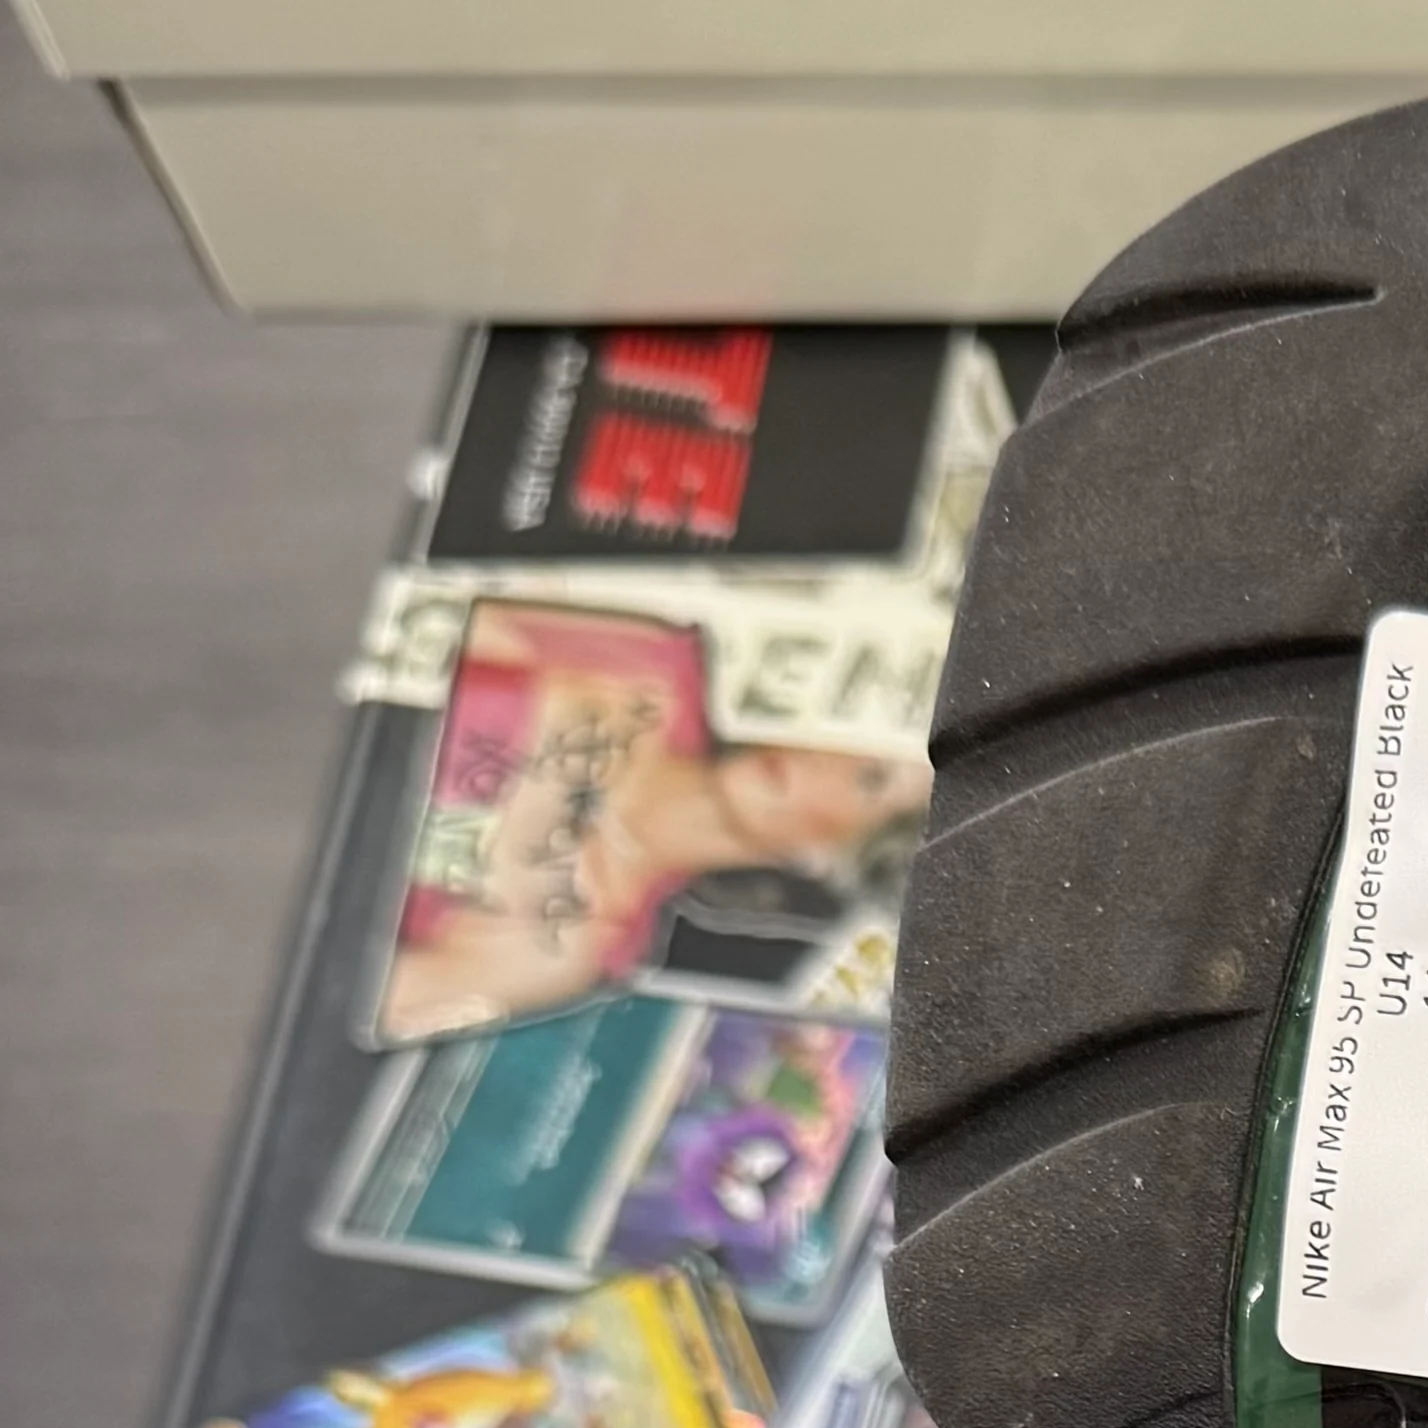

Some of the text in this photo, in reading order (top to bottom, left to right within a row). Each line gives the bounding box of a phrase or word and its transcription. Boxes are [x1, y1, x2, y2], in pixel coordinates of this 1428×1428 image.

[1378, 661, 1416, 758] Black
[1341, 768, 1400, 973] Undefeated
[1378, 948, 1414, 1019] U14
[1317, 1078, 1352, 1151] Max
[1308, 1159, 1340, 1212] Air
[1300, 1220, 1334, 1301] Nike
